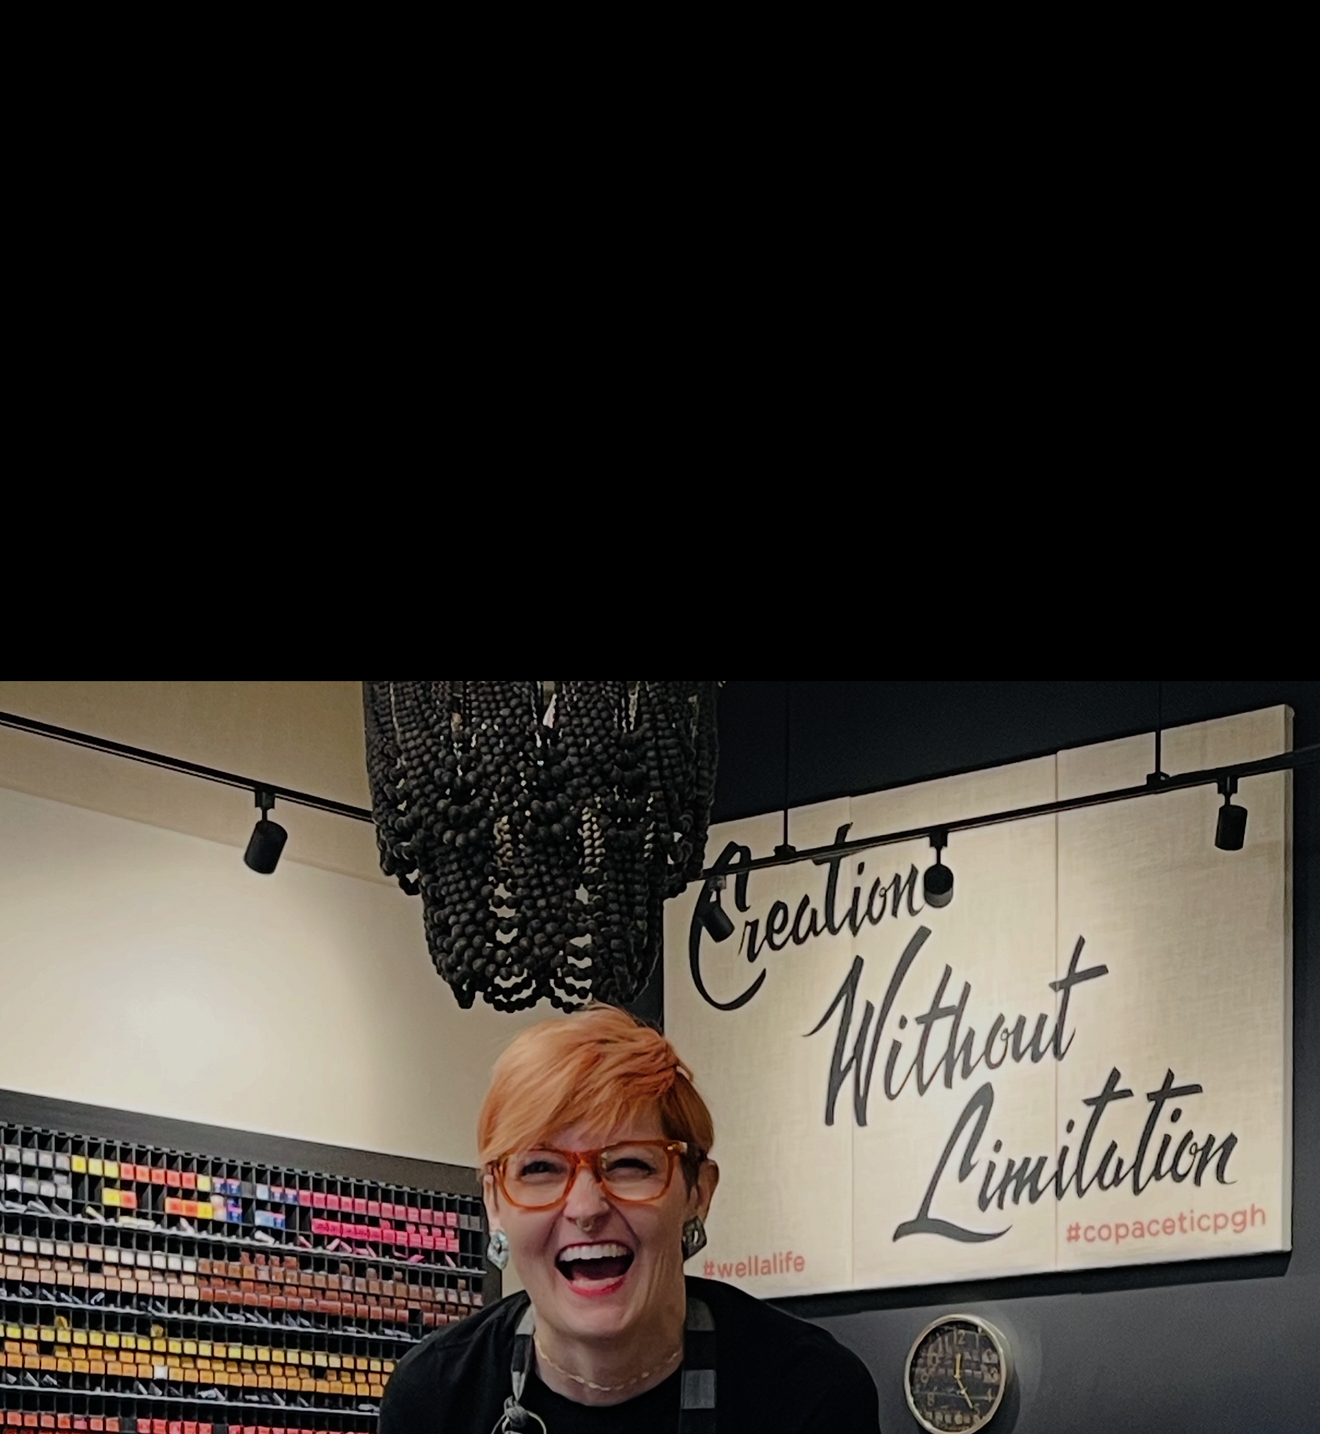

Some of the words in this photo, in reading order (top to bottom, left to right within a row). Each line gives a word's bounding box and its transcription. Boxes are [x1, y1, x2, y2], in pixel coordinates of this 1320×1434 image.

[689, 822, 925, 1011] Creation
[802, 925, 1109, 1127] Without
[893, 1067, 1238, 1243] Limitation
[1066, 1203, 1267, 1244] #copaceticpgh
[703, 1251, 806, 1279] #wellalife
